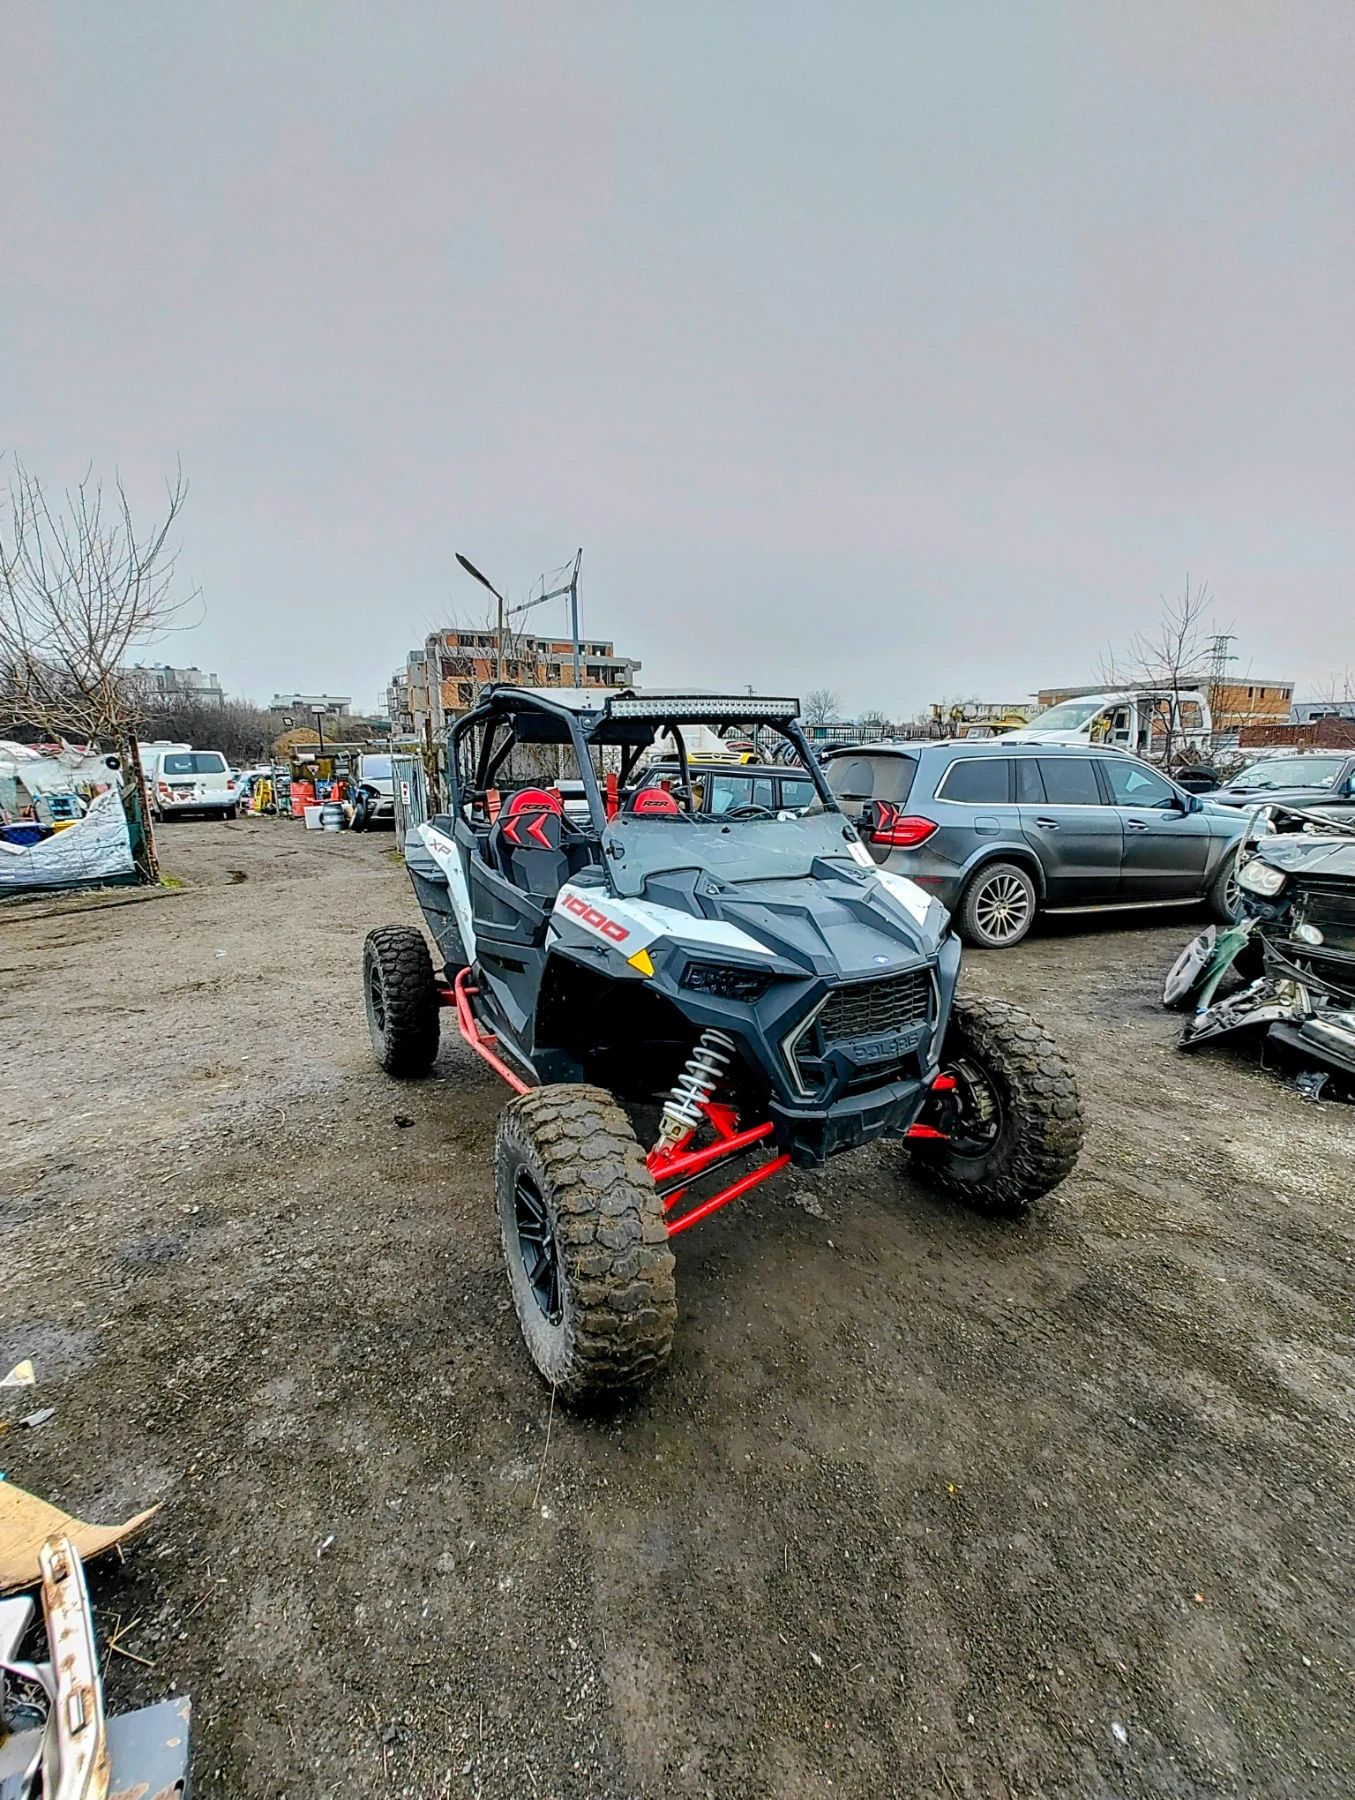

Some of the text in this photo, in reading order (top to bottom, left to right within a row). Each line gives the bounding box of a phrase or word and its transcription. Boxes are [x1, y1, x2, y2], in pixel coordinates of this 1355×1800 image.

[428, 838, 452, 855] XP
[561, 893, 631, 942] 1000
[853, 1033, 919, 1062] POLARIS
